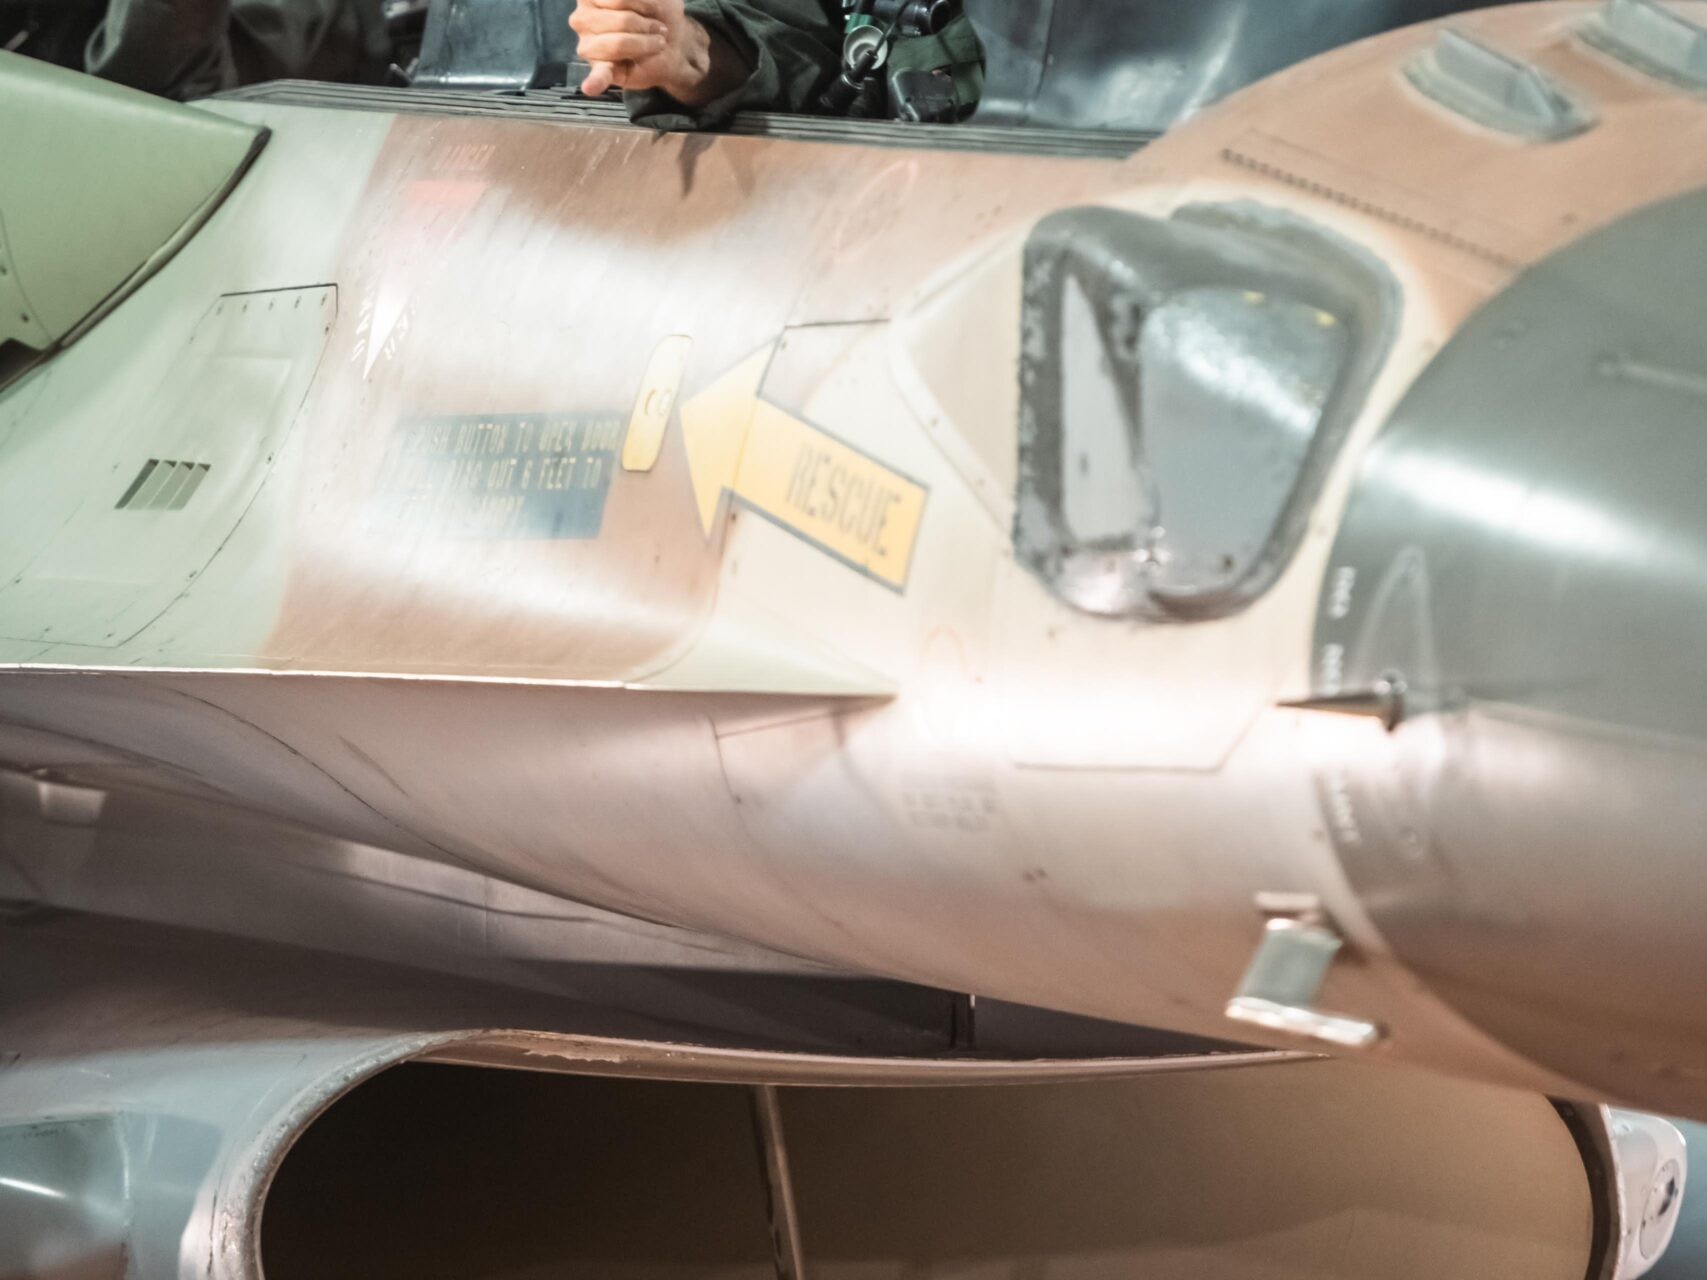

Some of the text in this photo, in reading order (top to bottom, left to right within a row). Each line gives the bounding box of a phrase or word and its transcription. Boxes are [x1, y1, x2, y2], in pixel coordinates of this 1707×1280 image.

[455, 423, 509, 454] BUTTON
[514, 422, 534, 453] TO
[539, 421, 577, 452] OPEN
[487, 458, 518, 489] OUT
[521, 459, 534, 490] 6
[538, 458, 577, 490] FEET
[582, 457, 603, 489] TO
[784, 441, 902, 558] RESCUE
